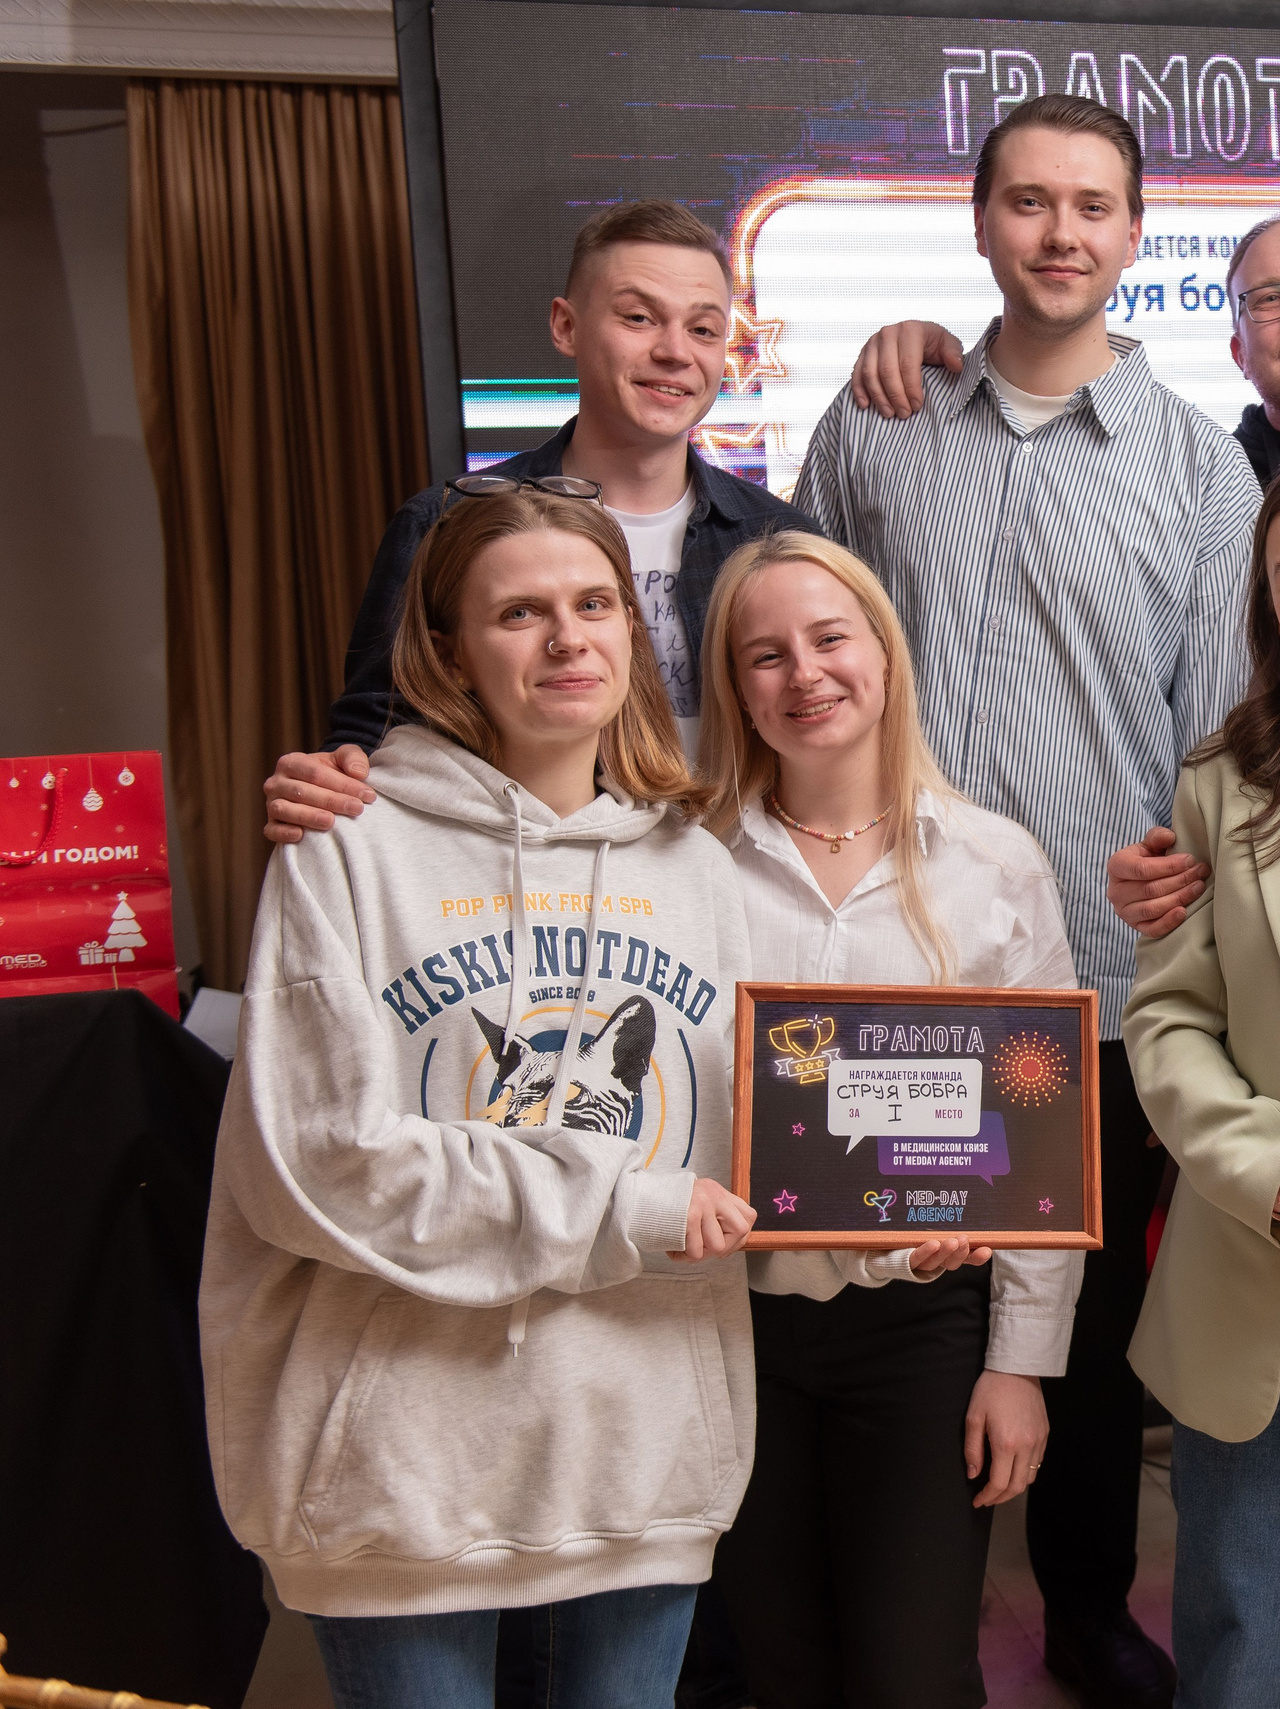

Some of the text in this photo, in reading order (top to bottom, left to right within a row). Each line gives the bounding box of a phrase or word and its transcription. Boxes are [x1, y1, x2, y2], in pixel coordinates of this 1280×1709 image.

[1136, 234, 1200, 260] АЕТСЯ
[53, 845, 139, 864] ГОДОМ!
[440, 897, 486, 918] POP
[618, 896, 654, 916] SPB
[528, 986, 596, 1003] SINCE 208
[859, 1024, 985, 1053] ГРАМОТА
[849, 1070, 963, 1082] НАГРАЖДАЕТСЯ КОМАНДА
[836, 1083, 968, 1100] СТРУЯ БОБРА
[848, 1108, 860, 1119] ЗА
[934, 1109, 963, 1119] МЕСТО
[893, 1142, 989, 1154] В МЕДИЦИНСКОМ КВИЗЕ
[893, 1156, 972, 1166] ОТ MEDDAY AGENCY!
[906, 1190, 968, 1206] MED-DAY
[906, 1206, 965, 1222] AGENCY
